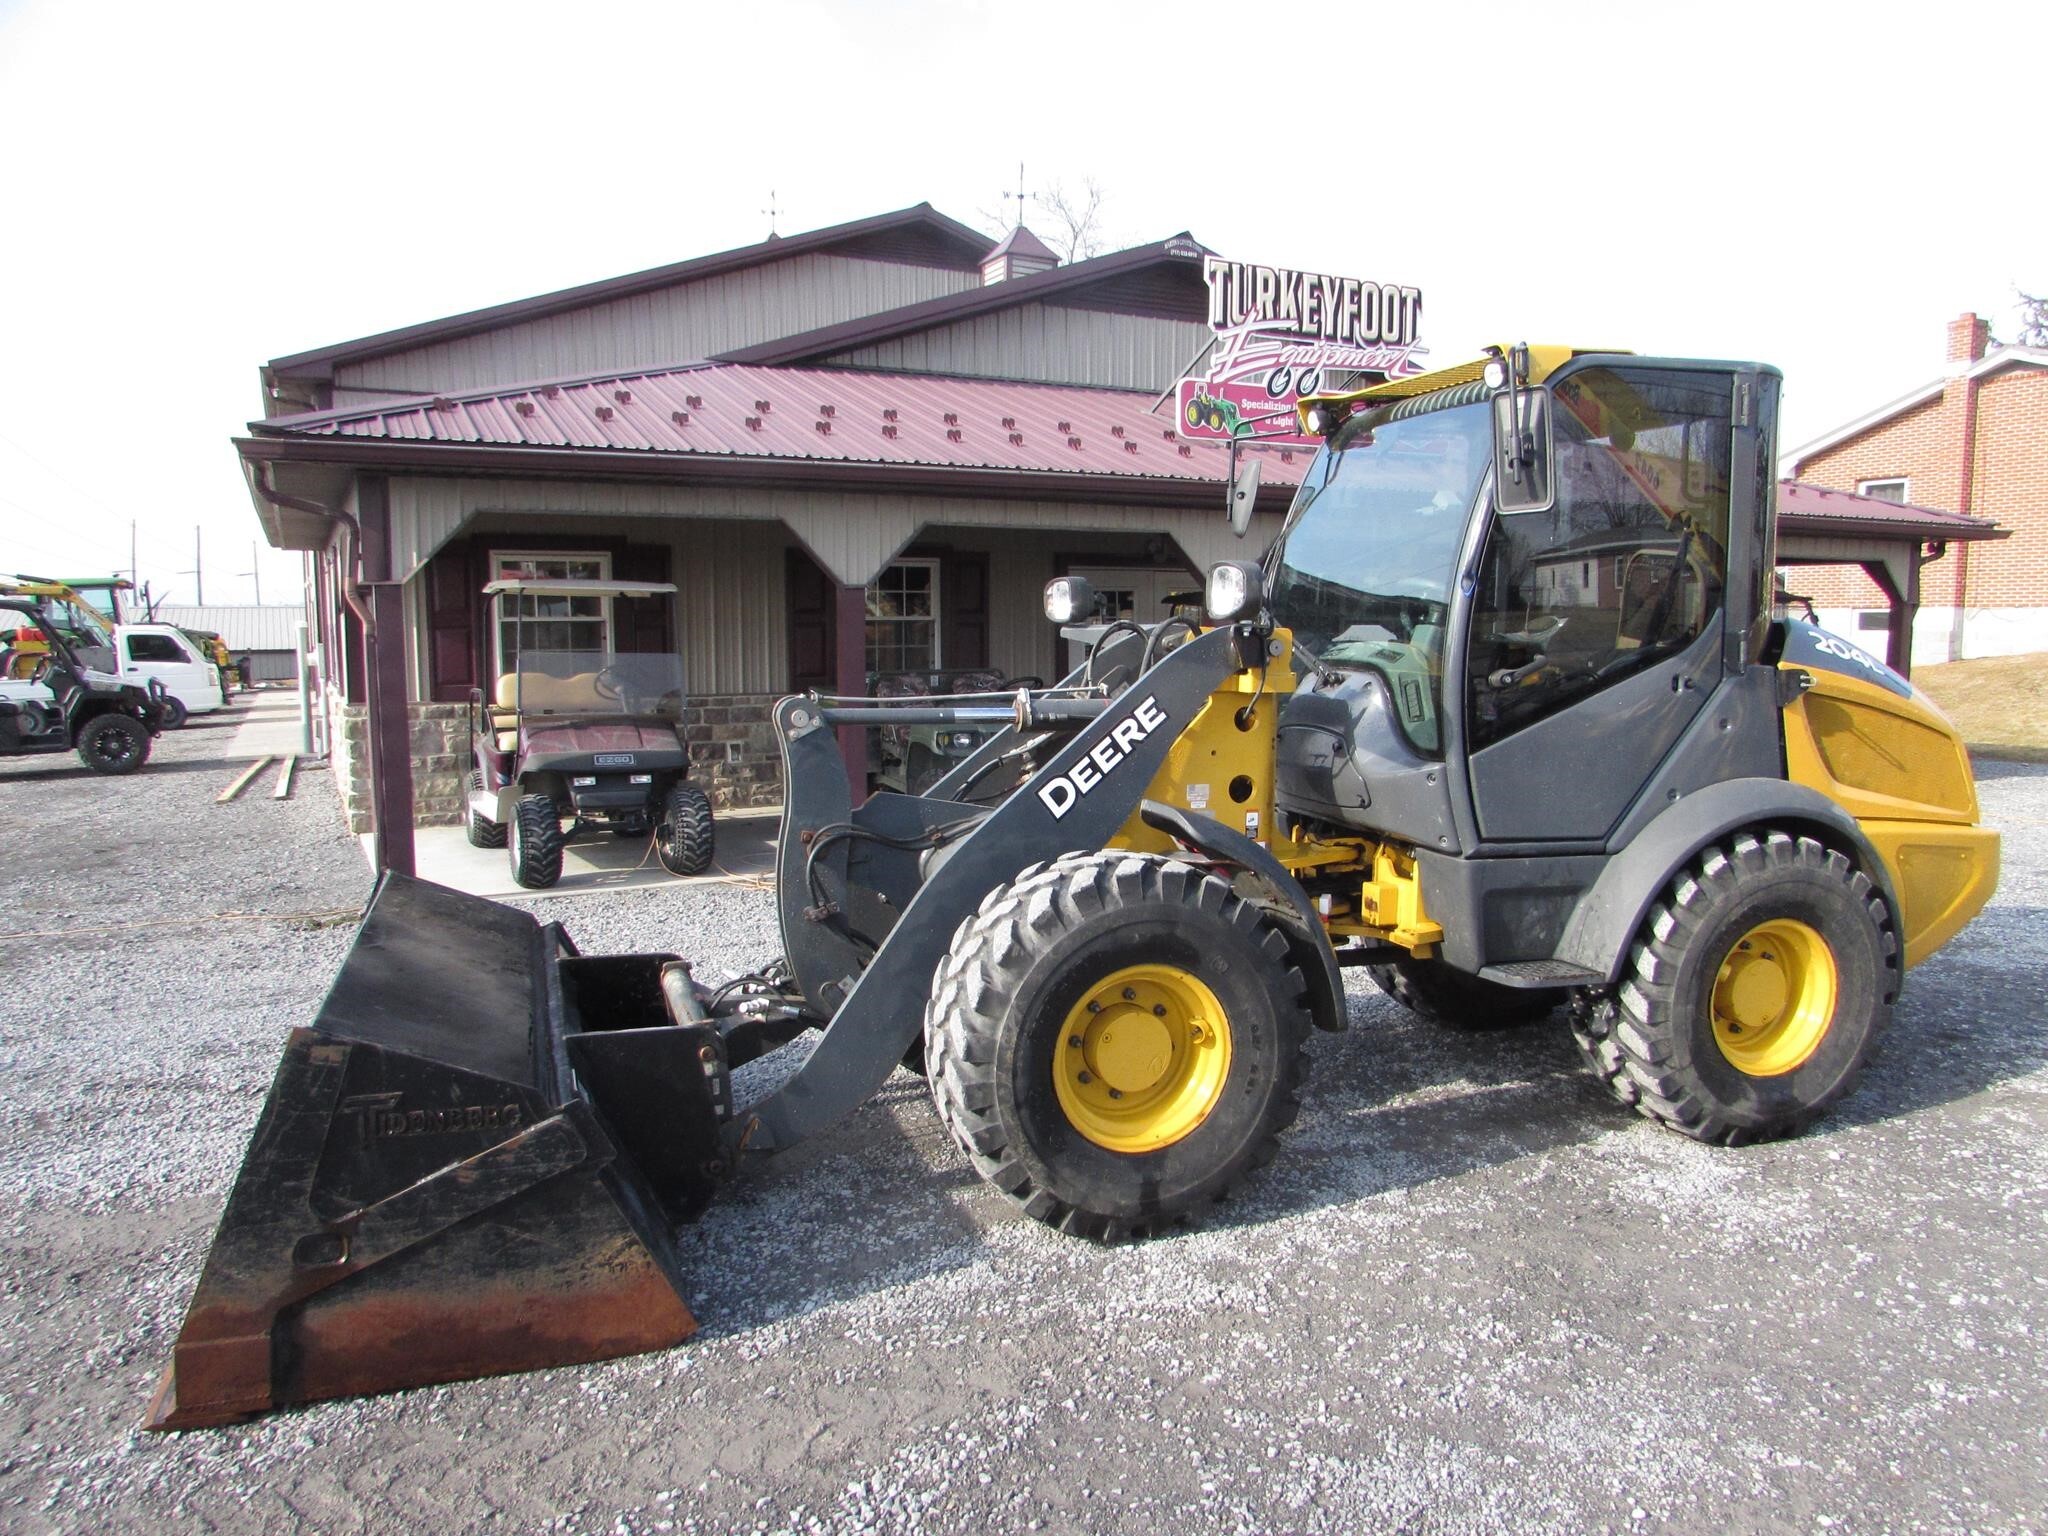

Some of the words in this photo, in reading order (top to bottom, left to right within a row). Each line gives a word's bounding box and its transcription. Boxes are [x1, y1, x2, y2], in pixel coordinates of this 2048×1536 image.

[1208, 258, 1422, 346] TURKEYFOOT
[1208, 306, 1430, 384] Equipment
[1241, 398, 1292, 412] Specializing
[1037, 695, 1168, 820] DEERE
